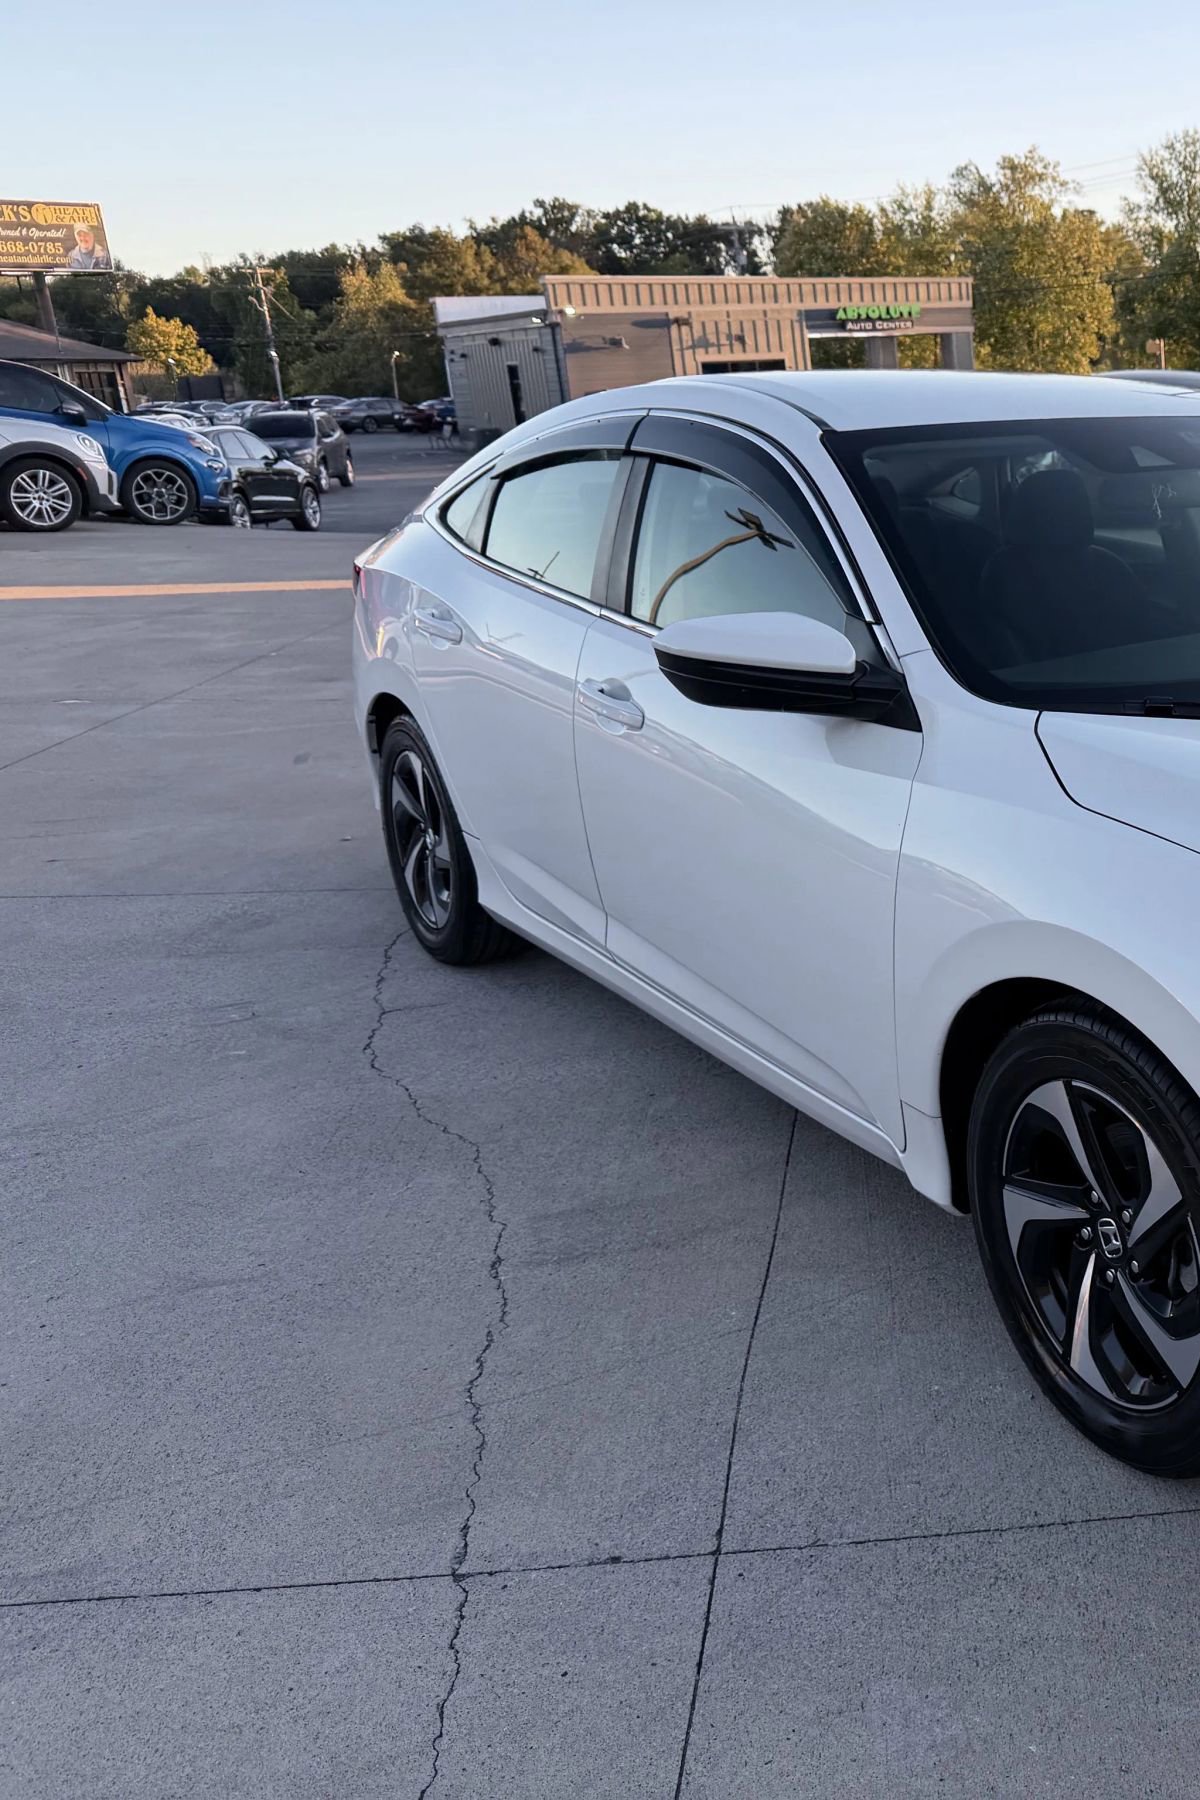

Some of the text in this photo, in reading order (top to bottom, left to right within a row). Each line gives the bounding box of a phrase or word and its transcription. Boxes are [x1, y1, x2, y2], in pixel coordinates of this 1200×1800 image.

[53, 207, 87, 215] HEAT
[55, 215, 65, 223] &
[69, 215, 90, 224] AIR
[0, 227, 21, 236] wned
[29, 227, 66, 239] Operated!
[0, 240, 63, 254] 668-0785
[836, 304, 921, 320] ABSOLUTE
